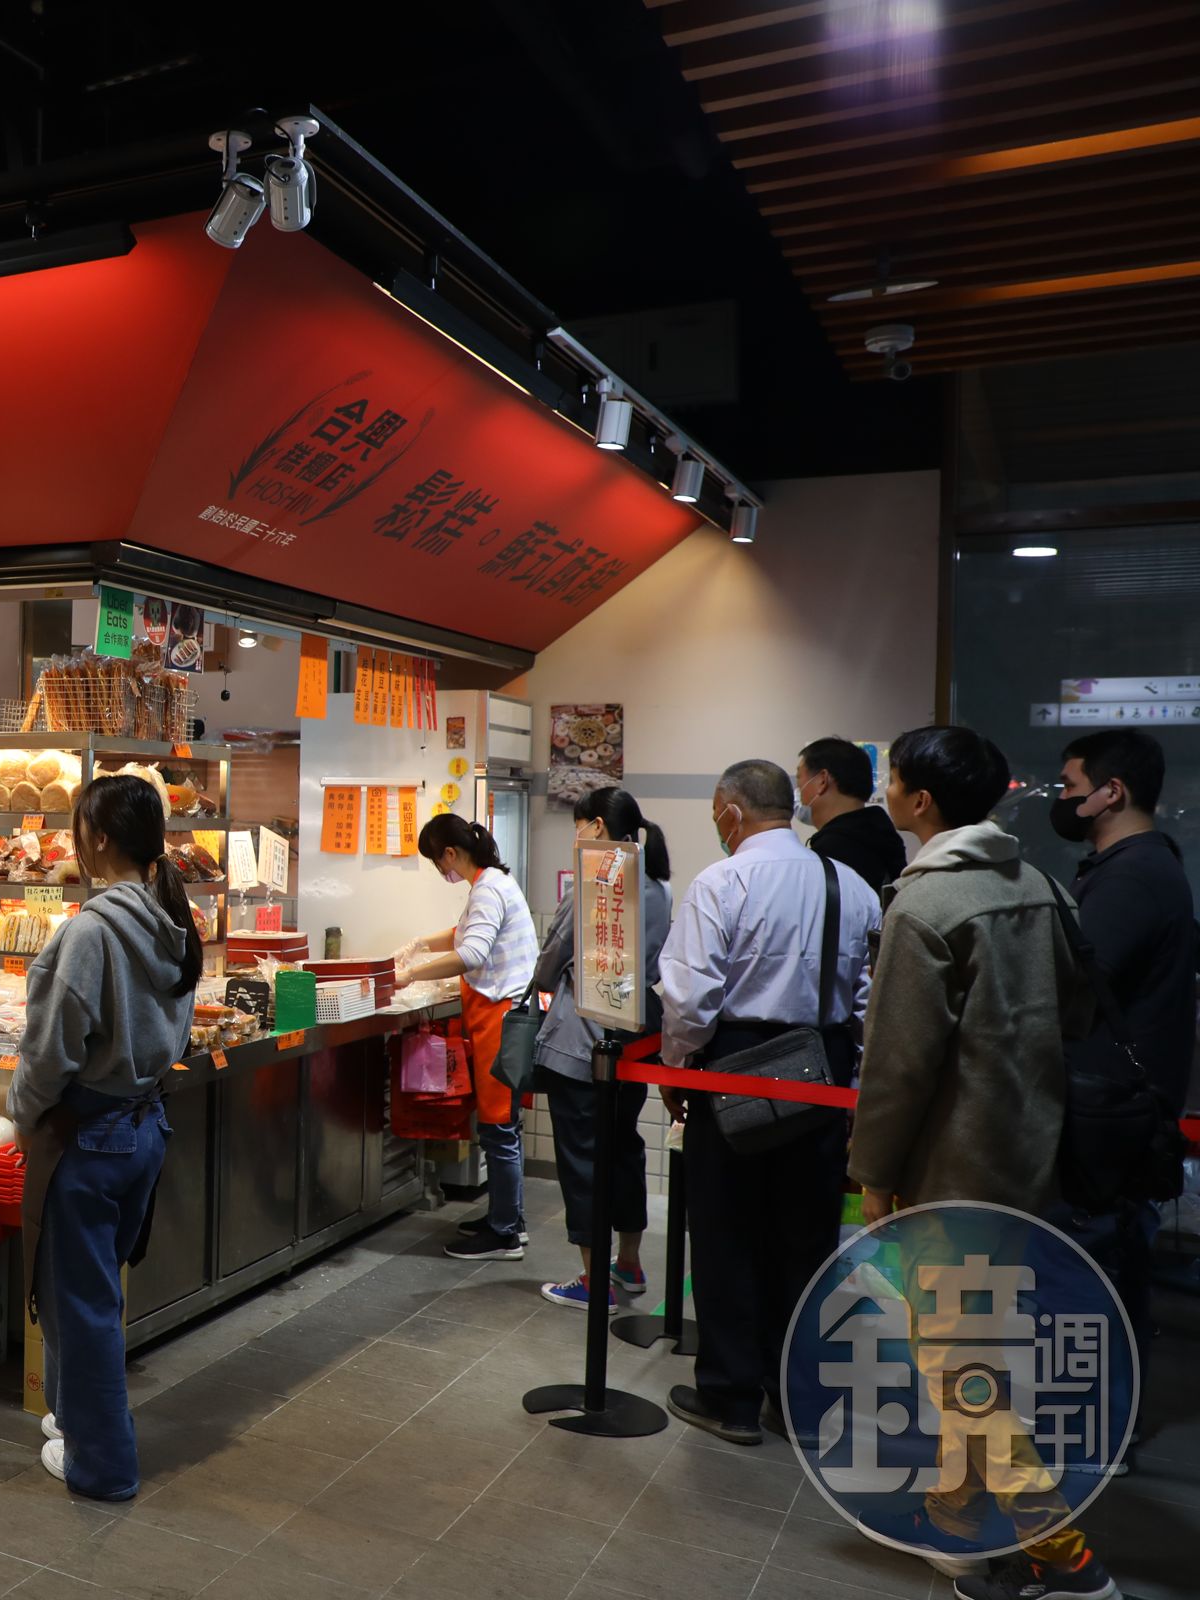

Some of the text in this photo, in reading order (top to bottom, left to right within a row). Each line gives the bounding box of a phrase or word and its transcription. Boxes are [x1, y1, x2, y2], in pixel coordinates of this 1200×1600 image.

[311, 398, 407, 461] 合興
[273, 440, 359, 492] 糕糰店
[246, 477, 319, 516] HOSHIN
[373, 469, 499, 556] 鬆糕
[197, 503, 298, 547] 創始於民國三十六年
[103, 631, 130, 648] 合作商家
[106, 611, 128, 629] Eats
[611, 872, 625, 976] 包子點心
